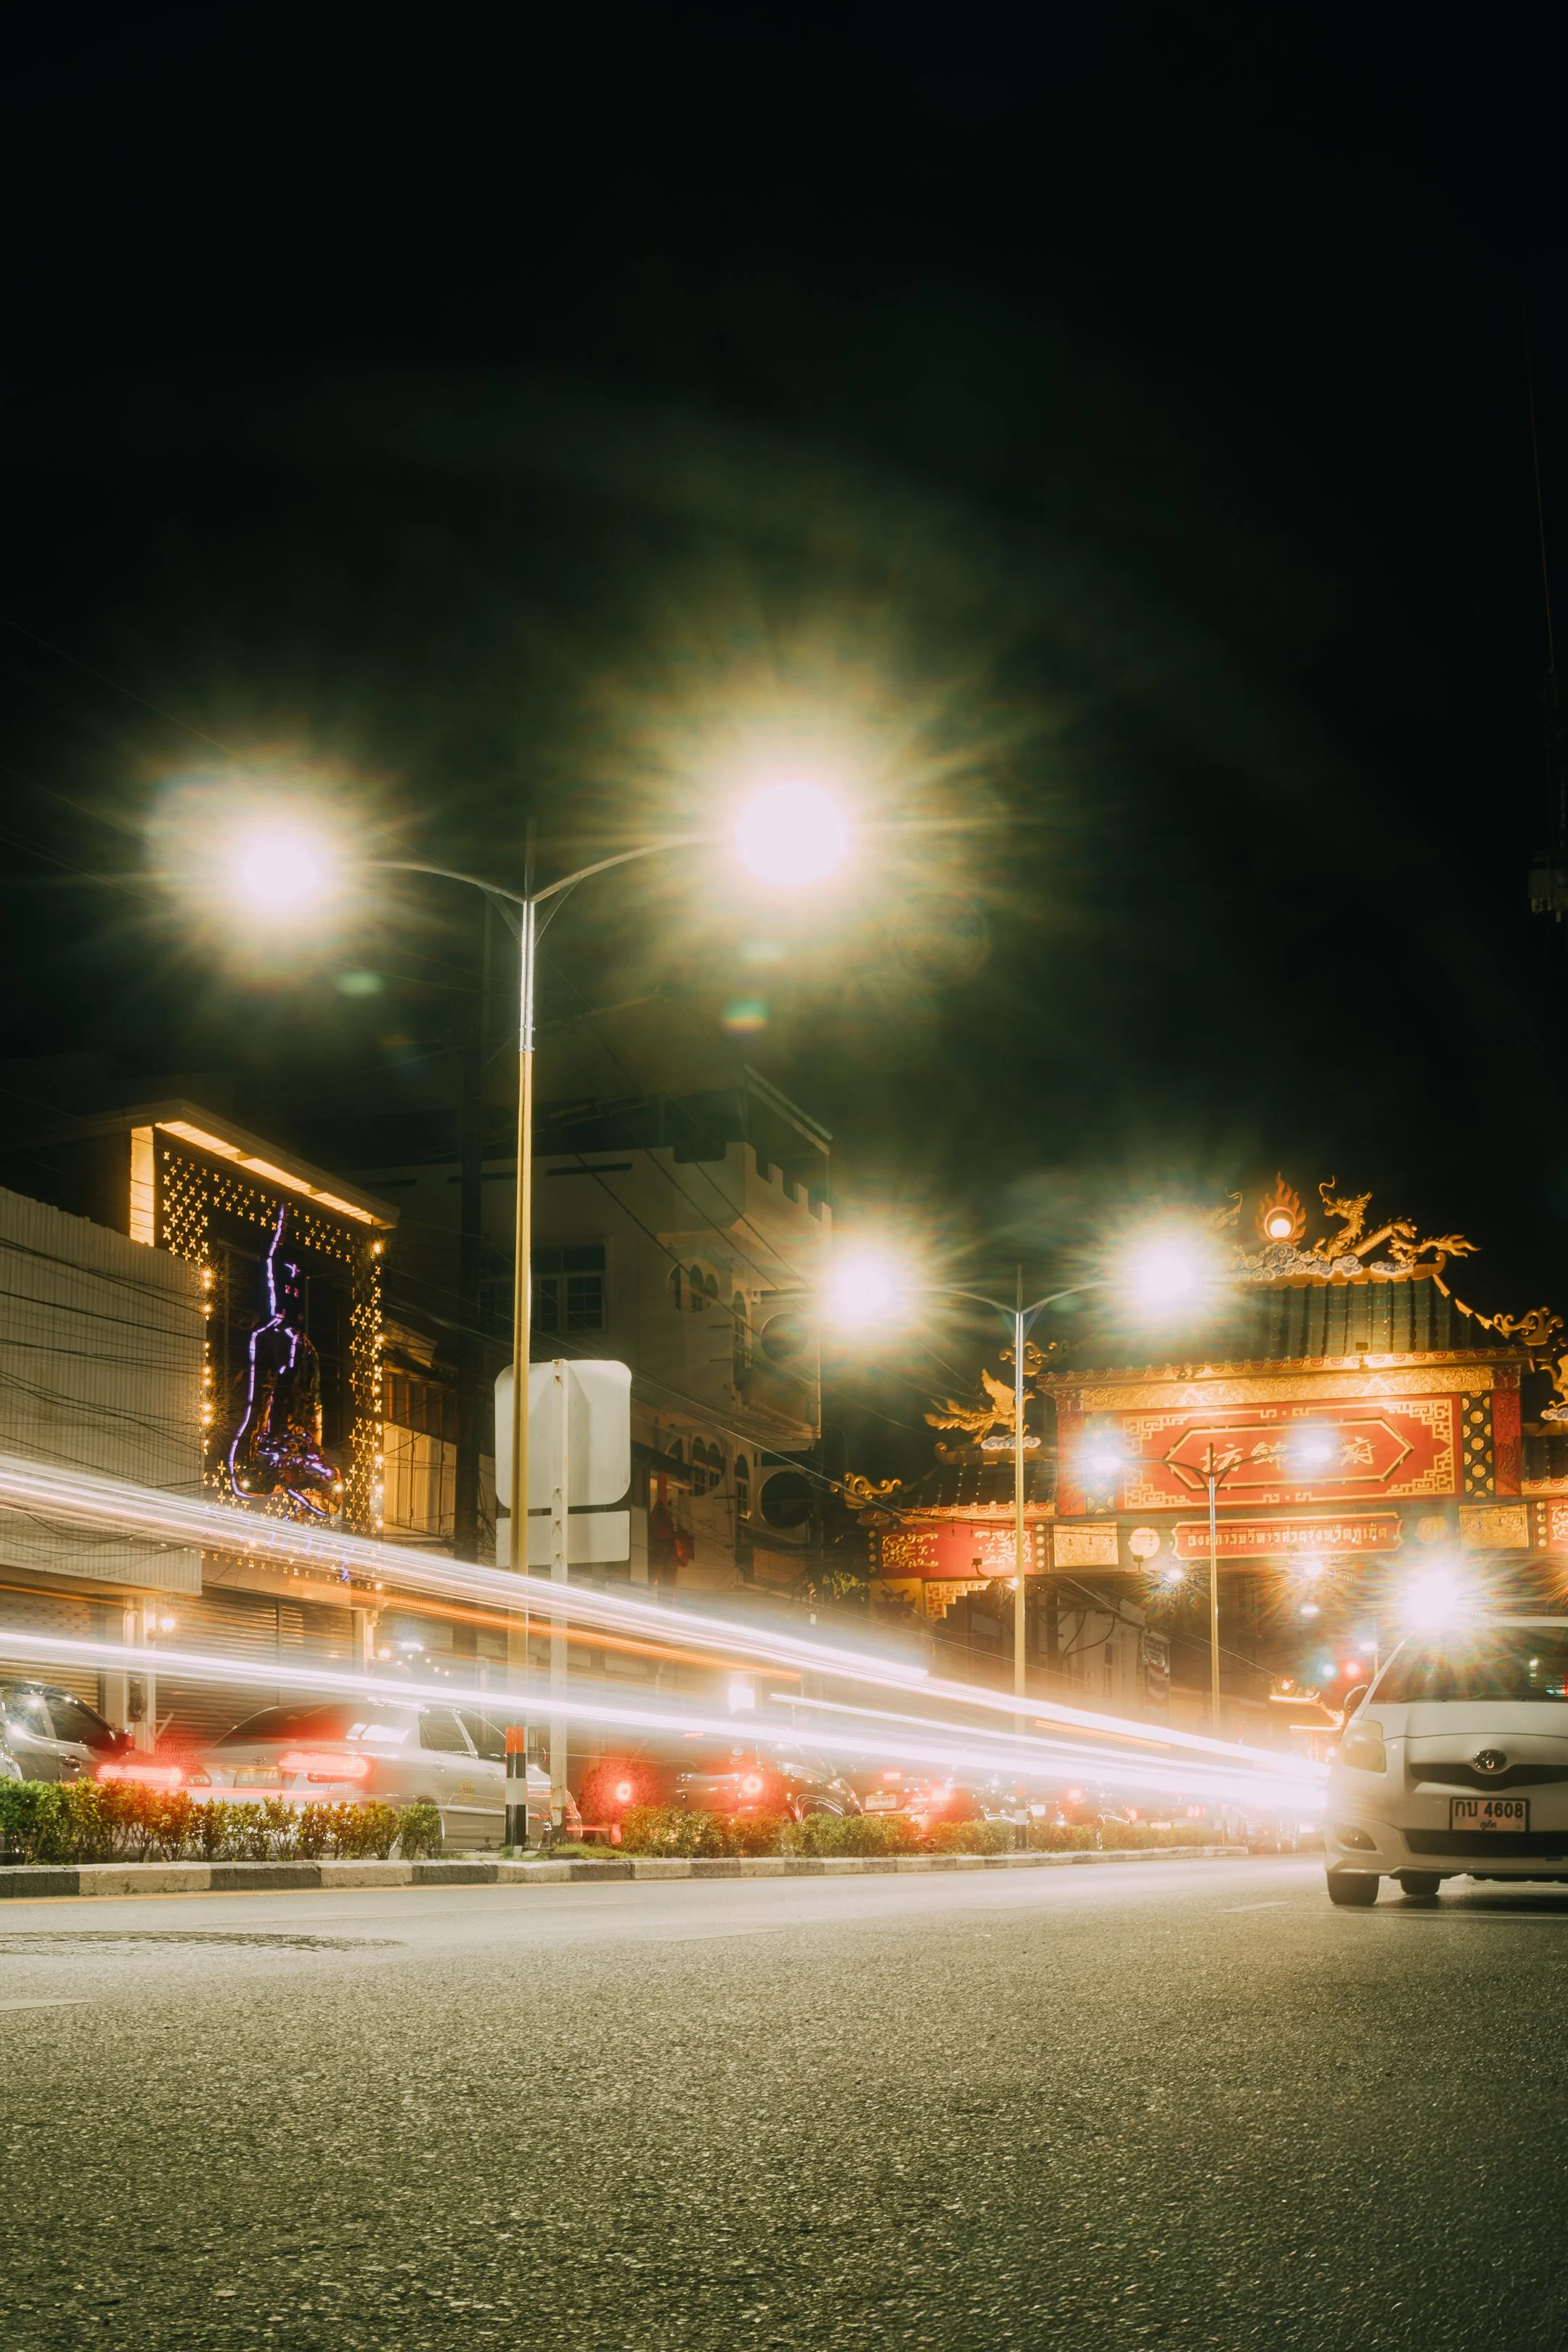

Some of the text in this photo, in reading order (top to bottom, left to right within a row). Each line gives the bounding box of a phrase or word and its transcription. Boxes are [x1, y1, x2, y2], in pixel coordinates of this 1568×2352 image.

[1188, 1522, 1387, 1547] องคการบริหารส่วนจังหวัดภูเก็ต
[1484, 1802, 1523, 1818] 4608
